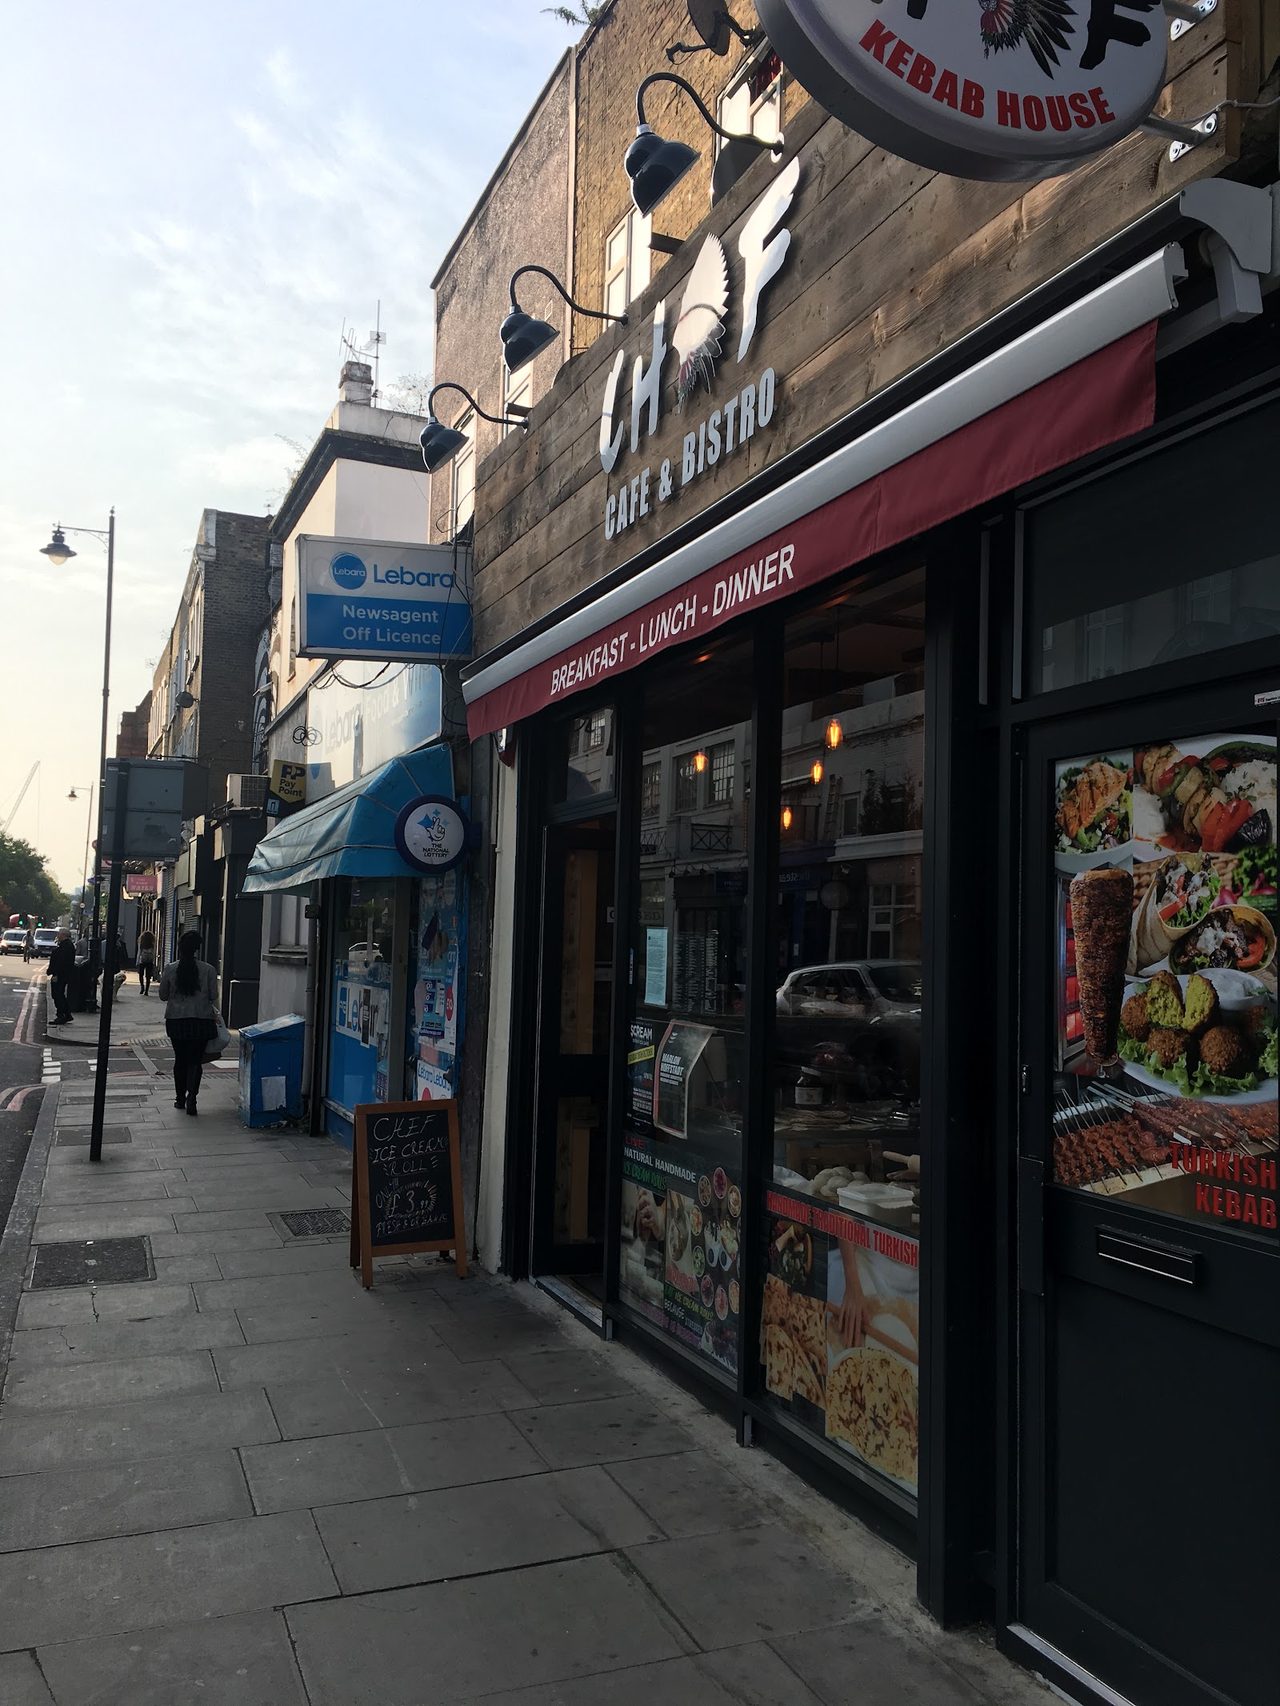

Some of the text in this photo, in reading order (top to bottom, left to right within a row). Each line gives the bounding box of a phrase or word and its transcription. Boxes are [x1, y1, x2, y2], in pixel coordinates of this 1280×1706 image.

[858, 19, 1116, 132] KEBAB HOUSE
[604, 367, 776, 541] CAFE & BISTRO
[334, 566, 366, 577] Lebara
[373, 563, 455, 588] Lebara
[343, 604, 439, 624] Newsagent
[550, 637, 629, 696] BREAKFAST
[639, 594, 697, 653] LUNCH
[713, 544, 796, 617] DINNER
[343, 626, 441, 645] Off Licence
[278, 786, 304, 798] Point
[279, 778, 297, 789] Pay
[630, 1024, 653, 1040] SCREAM
[373, 1114, 437, 1142] CHEF
[372, 1136, 447, 1163] ICE CREAM
[389, 1159, 428, 1175] ROLL
[624, 1146, 697, 1183] NATURAL HANDMADE
[1169, 1140, 1278, 1191] TURKISH
[1195, 1181, 1278, 1230] KEBAB
[812, 1206, 871, 1248] TRADITIONAL
[873, 1229, 919, 1268] TURKISH
